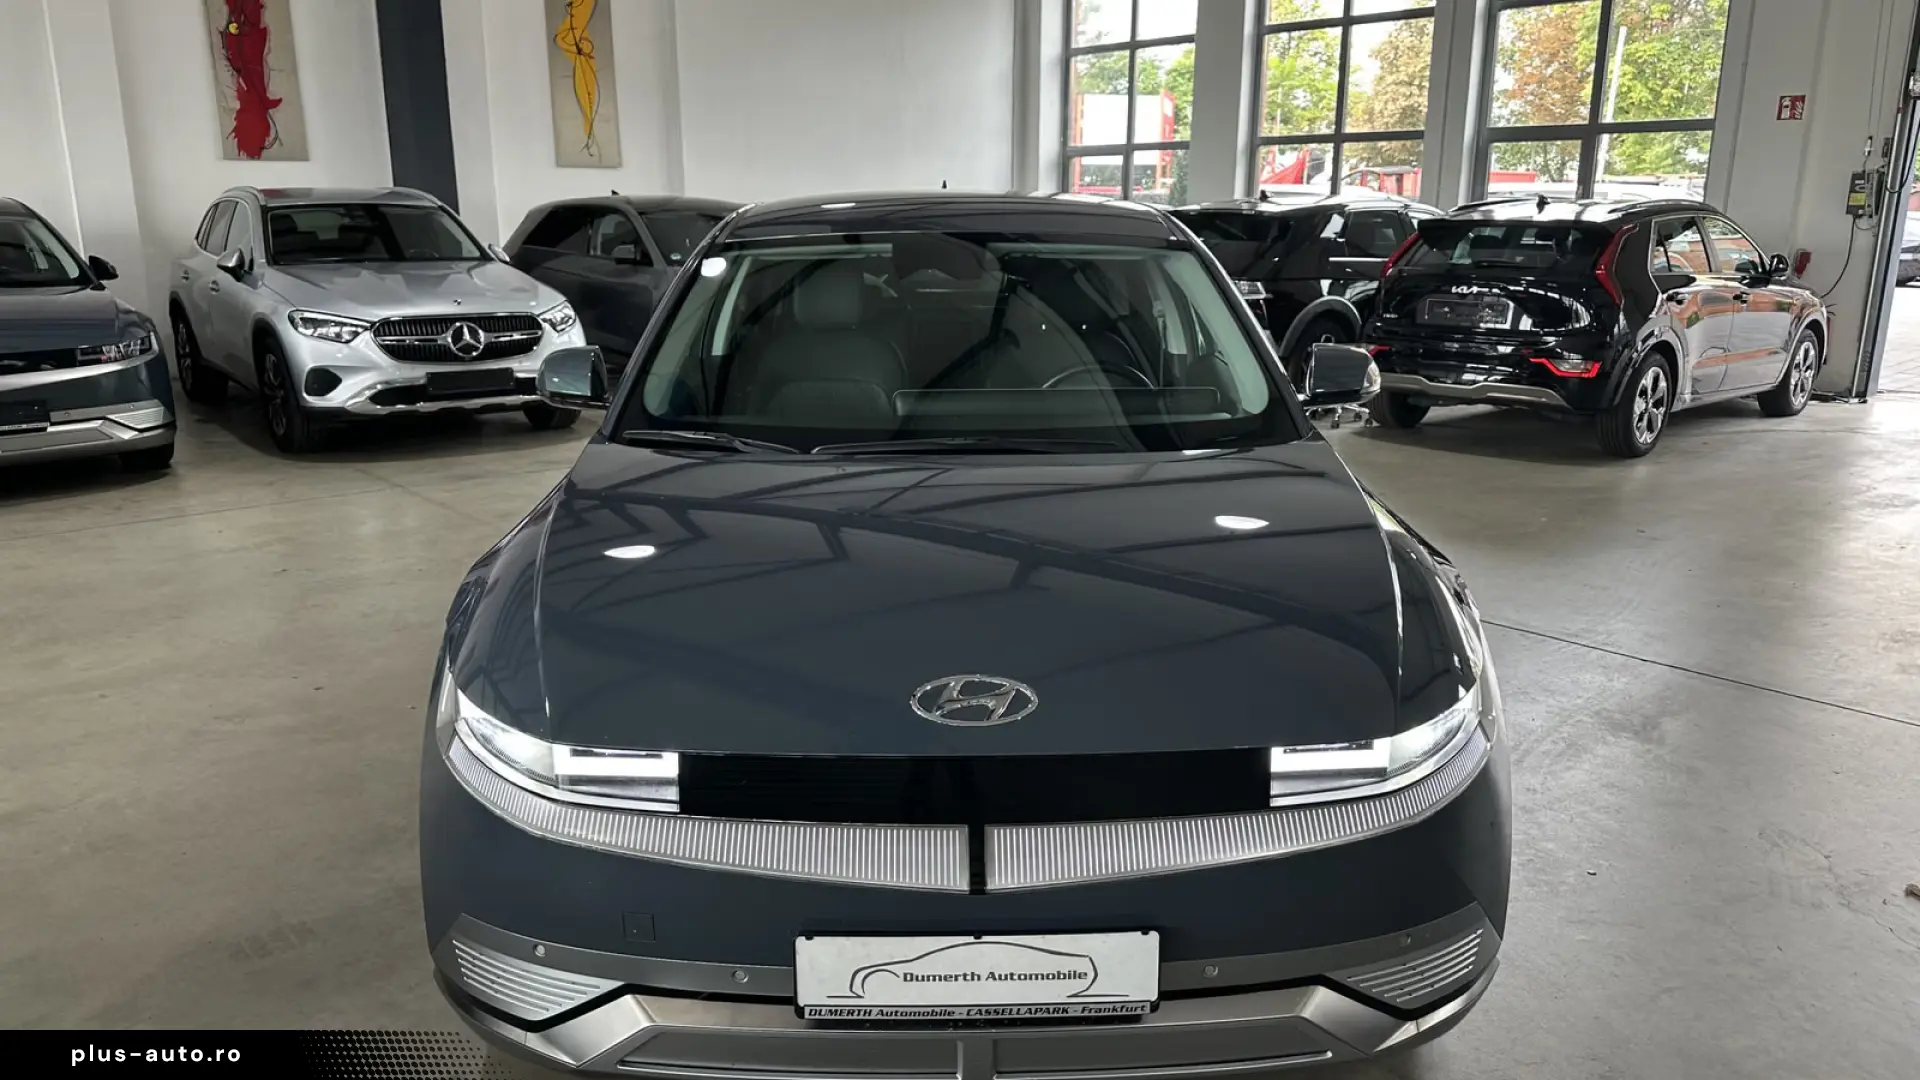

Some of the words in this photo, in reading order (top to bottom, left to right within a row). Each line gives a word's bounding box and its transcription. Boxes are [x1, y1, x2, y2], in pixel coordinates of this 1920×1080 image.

[903, 971, 981, 983] Dumerth
[985, 970, 1088, 982] Automobile
[808, 1008, 873, 1017] DUMERTH
[874, 1008, 956, 1018] Automobile
[966, 1006, 1070, 1017] CASSELLAPARK
[1080, 1004, 1148, 1015] Frankfurt
